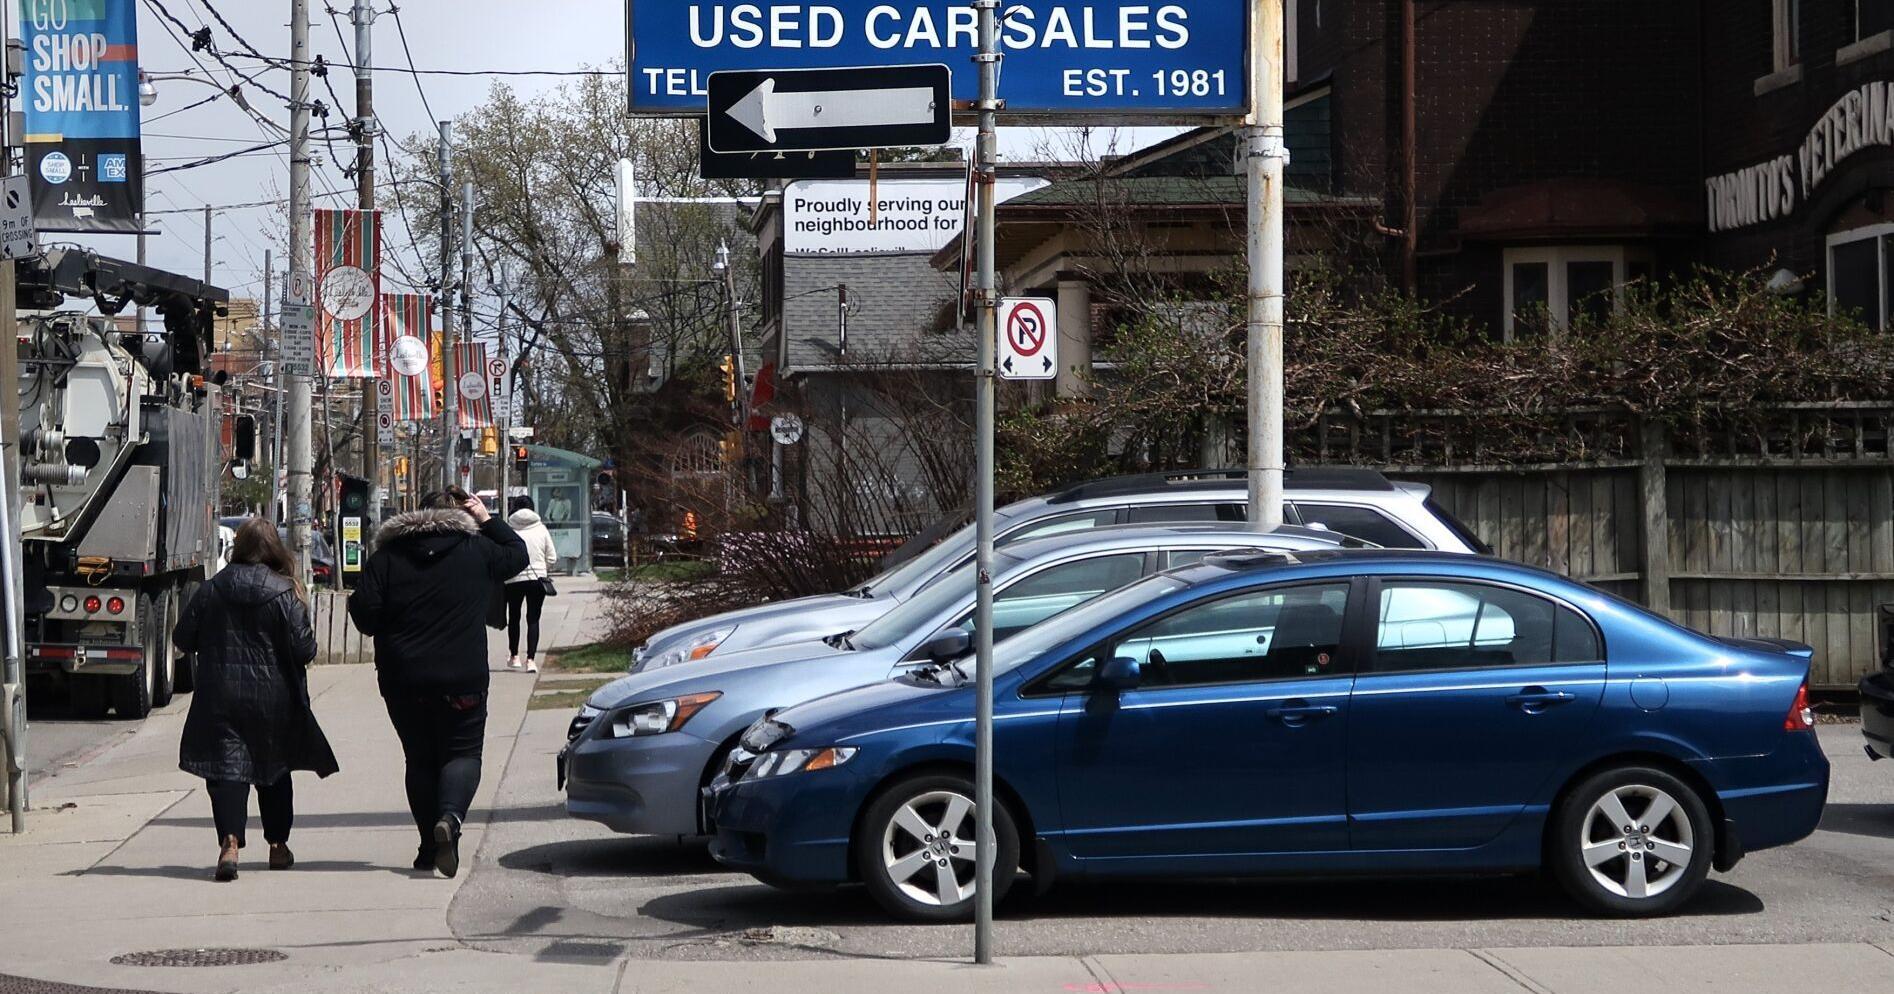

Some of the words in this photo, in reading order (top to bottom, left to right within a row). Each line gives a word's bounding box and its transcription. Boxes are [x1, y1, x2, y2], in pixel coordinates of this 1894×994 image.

[32, 0, 67, 31] GO
[688, 4, 845, 49] USED
[863, 5, 979, 49] CAR
[1001, 5, 1190, 49] SALES
[32, 32, 107, 72] SHOP
[33, 74, 129, 113] SMALL.
[1063, 69, 1140, 96] EST.
[1152, 69, 1226, 96] 1981
[795, 198, 861, 215] Proudly
[938, 199, 965, 212] our
[1705, 155, 1796, 232] TORONTO'S
[1, 228, 33, 243] CROSSING
[795, 216, 928, 235] neighbourhood
[934, 216, 958, 230] for
